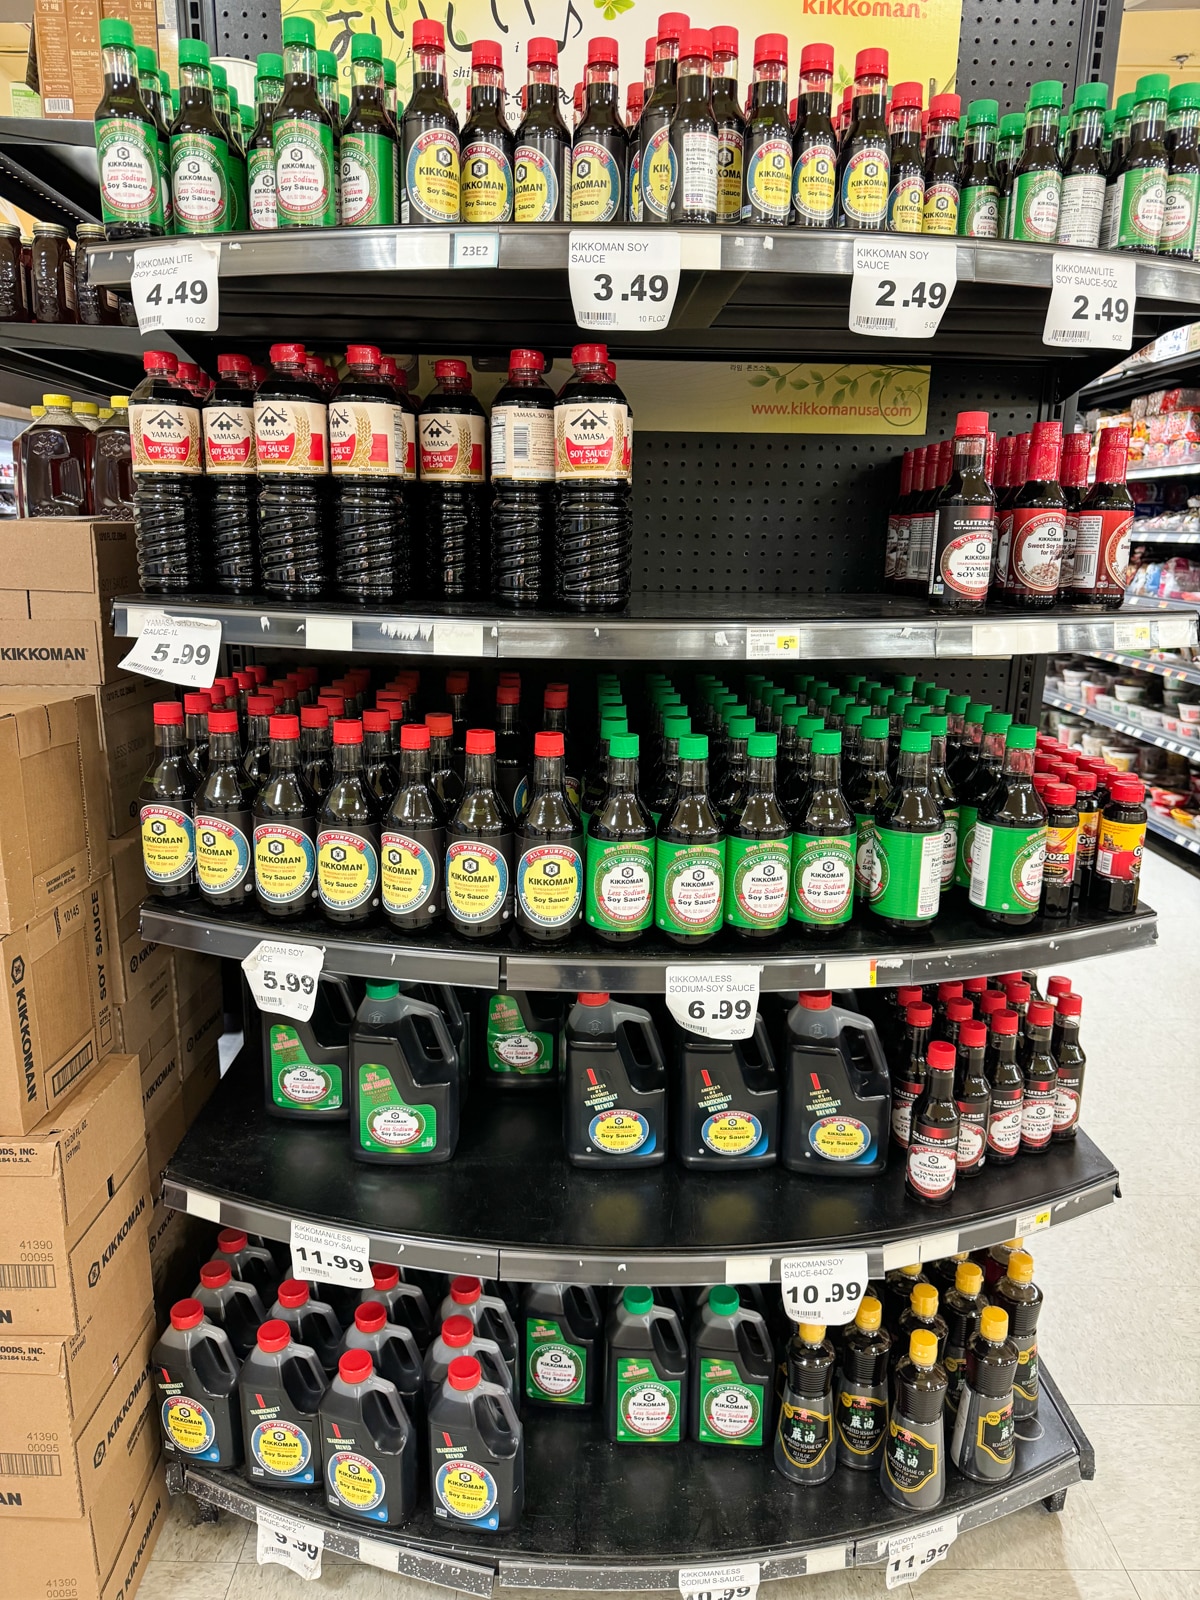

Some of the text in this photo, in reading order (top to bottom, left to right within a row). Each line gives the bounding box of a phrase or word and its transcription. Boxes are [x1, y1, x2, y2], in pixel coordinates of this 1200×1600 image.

[107, 174, 146, 182] Less Sodium
[280, 176, 318, 184] Less Sodium
[462, 246, 488, 256] 23E2
[571, 242, 648, 252] KIKKOMAN SOY
[571, 254, 606, 264] SAUCE
[857, 248, 930, 260] KIKKOMAN SOY
[136, 254, 192, 270] KIKKOMAN LITE
[857, 260, 890, 270] SAUCE
[134, 266, 179, 278] SOY SAUCE
[1056, 264, 1114, 277] KIKKOMAN/LITE
[1056, 276, 1118, 288] SOY SAUCE-5OZ
[146, 280, 208, 306] 4.49
[594, 274, 668, 302] 3.49
[876, 280, 946, 309] 2.49
[1072, 294, 1128, 323] 2.49
[751, 402, 912, 417] www.kikkomanusa.com
[148, 446, 186, 454] SOY SAUCE
[224, 448, 246, 456] SAUCE
[570, 450, 609, 458] SOY SAUCE
[143, 628, 178, 636] SAUCE-1L
[1, 648, 86, 660] KIKKOMAN
[151, 643, 210, 666] 5.99
[258, 854, 301, 864] KIKKOMAN
[528, 877, 574, 886] KIKKOMAN
[808, 882, 846, 890] Less Sodium
[748, 886, 784, 894] Less Sodium
[534, 896, 546, 904] Soy
[607, 896, 620, 904] Soy
[64, 904, 80, 923] 10145
[91, 890, 107, 1000] SOY SAUCE
[288, 948, 304, 957] SOY
[264, 970, 314, 995] 5.99
[669, 975, 732, 984] KIKKOMA/LESS
[669, 984, 756, 993] SODIUM-SOY SAUCE
[688, 999, 752, 1020] 6.99
[16, 986, 37, 1102] KIKKOMAN
[146, 1058, 176, 1102] KIKKOMAN
[20, 1148, 38, 1156] INC.
[914, 1171, 926, 1180] SOY
[920, 1170, 946, 1178] TAMARI
[102, 1195, 146, 1268] KIKKOMAN
[294, 1224, 352, 1242] KIKKOMAN/LESS
[19, 1240, 53, 1250] 41390
[294, 1232, 366, 1254] SODIUM SOY-SAUCE
[20, 1252, 54, 1262] 00095
[296, 1246, 364, 1272] 11.99
[784, 1258, 844, 1270] KIKKOMAN/SOY
[784, 1268, 834, 1279] SAUCE-64OZ
[786, 1282, 861, 1304] 10.99
[108, 1361, 152, 1444] KIKKOMAN
[715, 1402, 748, 1410] KIKKOMAN
[26, 1432, 58, 1442] 41390
[27, 1443, 60, 1452] 00095
[262, 1440, 298, 1448] KIKKOMAN
[338, 1470, 372, 1484] KIKKOMAN
[448, 1480, 484, 1490] KIKKOMAN
[258, 1510, 306, 1530] KIKKOMAN/SOY
[889, 1526, 944, 1548] KADOYA/SESAME
[124, 1496, 161, 1592] KIKKOMAN
[890, 1548, 900, 1556] OIL
[890, 1544, 949, 1572] 11.99
[681, 1568, 741, 1578] KIKKOMAN/LESS
[46, 1578, 78, 1588] 41390
[681, 1574, 744, 1587] SODIUM S-SAUCE
[46, 1588, 78, 1598] 00095
